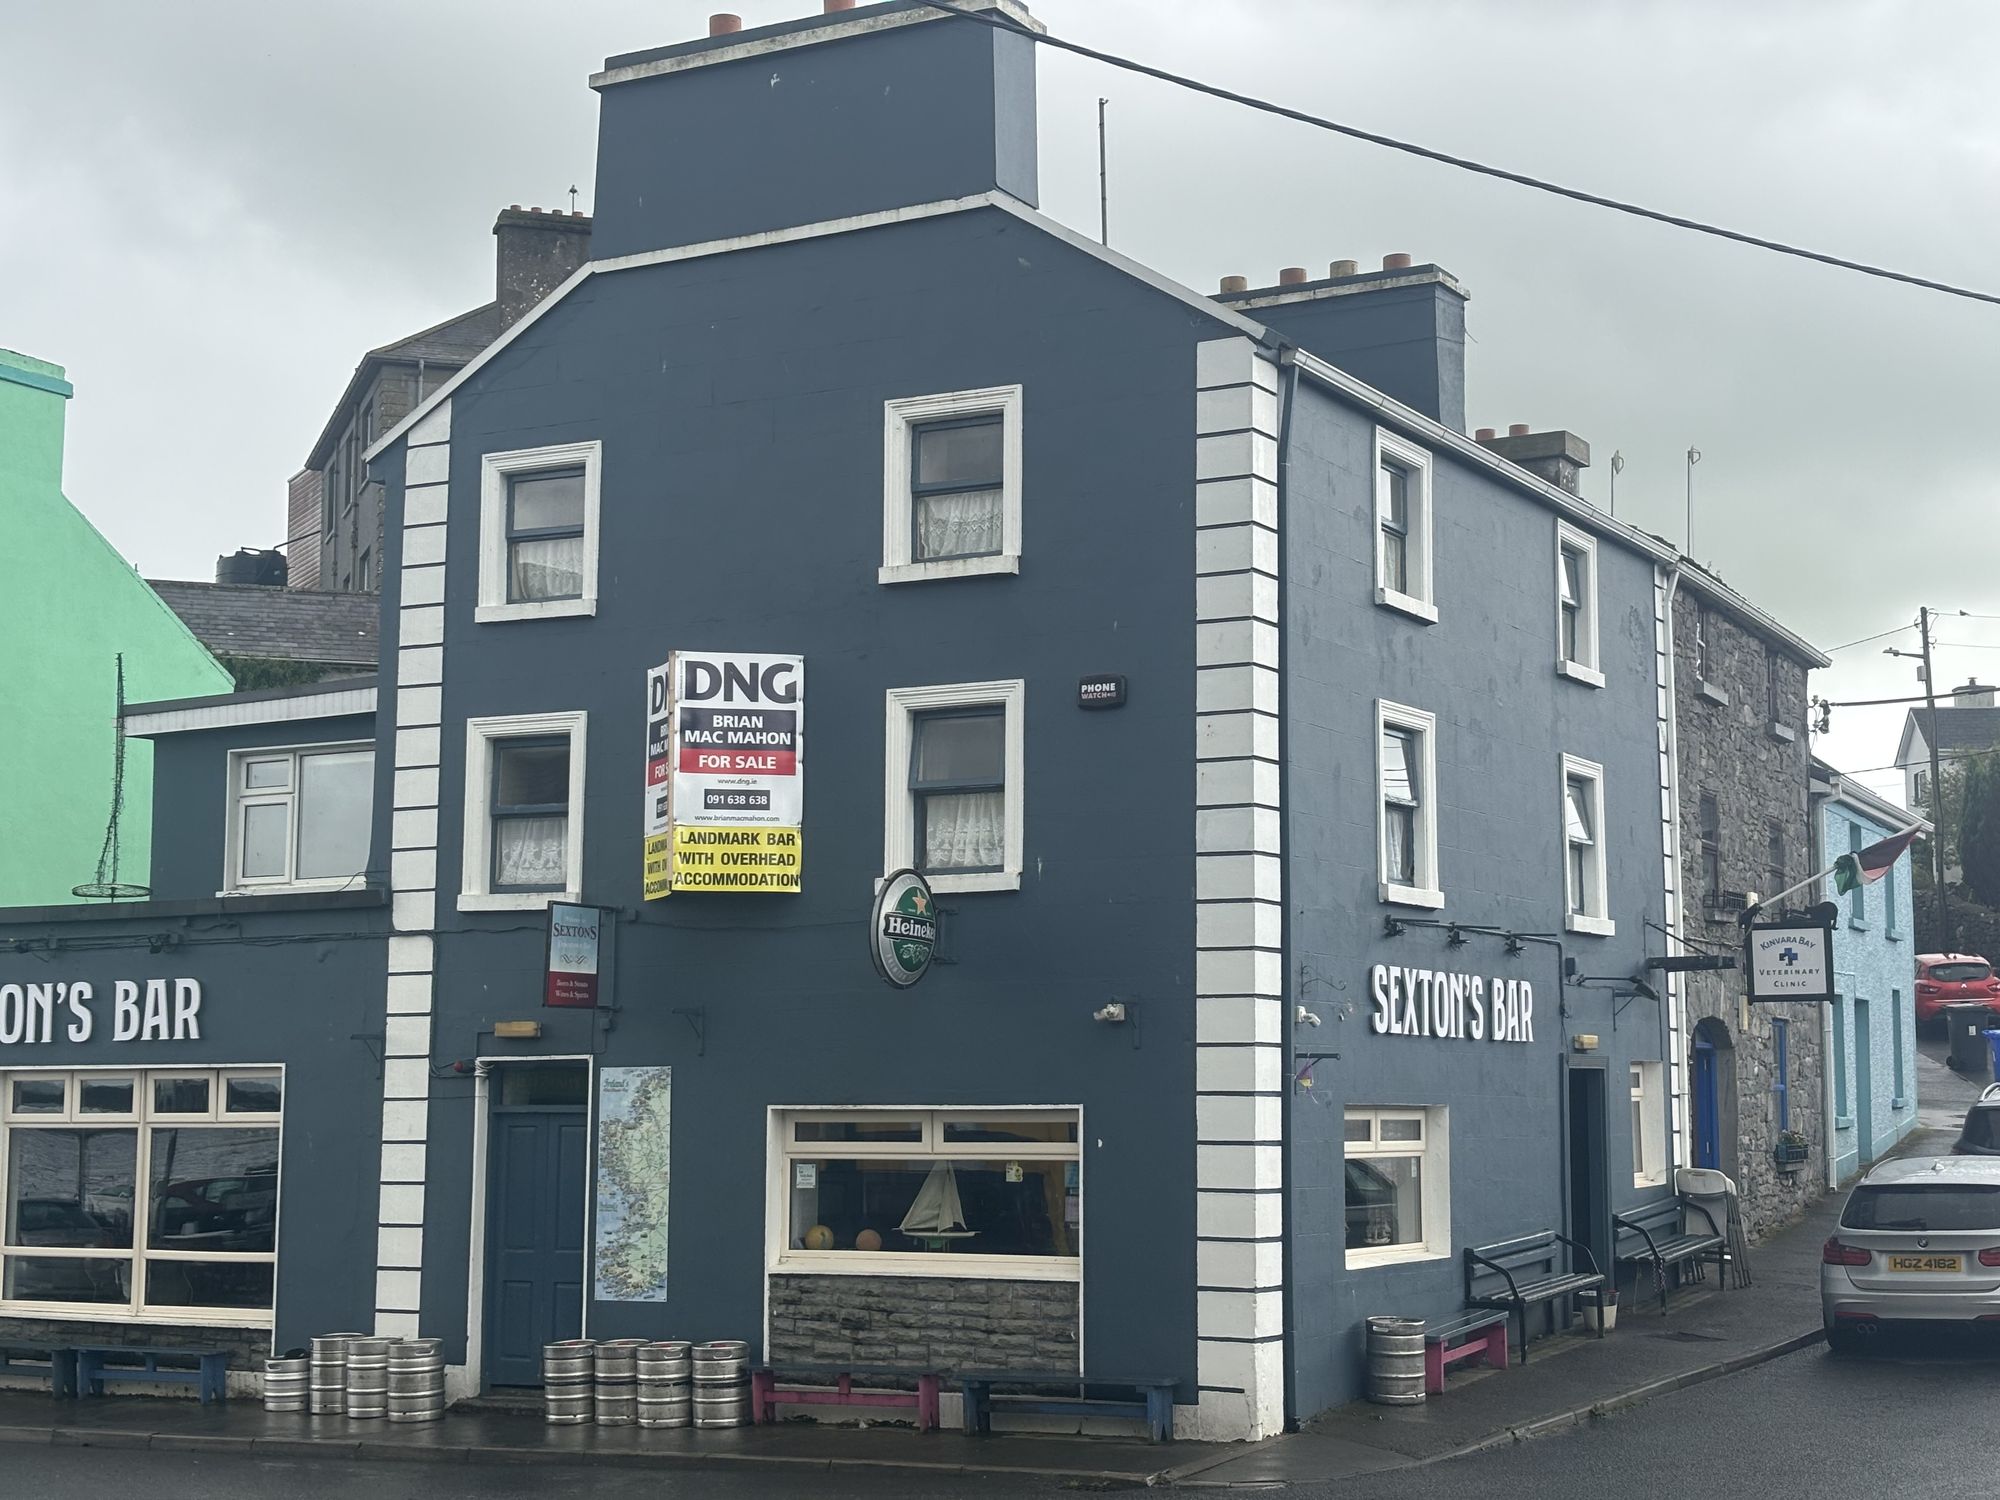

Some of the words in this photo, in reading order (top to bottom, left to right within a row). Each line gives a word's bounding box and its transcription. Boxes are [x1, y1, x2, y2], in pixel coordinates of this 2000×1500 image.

[685, 660, 797, 704] DNG
[1081, 683, 1116, 692] PHONE
[712, 715, 763, 728] BRIAN
[685, 730, 724, 743] MAC
[727, 731, 791, 745] MAHON
[699, 755, 731, 768] FOR
[735, 755, 777, 769] SALE
[717, 778, 757, 786] www.dng.ie
[707, 794, 724, 804] 091
[727, 795, 746, 804] 638
[749, 795, 767, 805] 638
[680, 832, 761, 846] LANDMARK
[767, 833, 795, 846] BAR
[678, 851, 714, 865] WITH
[721, 852, 795, 866] OVERHEAD
[675, 872, 799, 887] ACCOMMODATION
[553, 922, 597, 940] SEXTONS
[1760, 936, 1797, 950] KINVARA
[1798, 936, 1816, 948] BAY
[1759, 968, 1820, 976] VETERINARY
[1774, 980, 1807, 988] CLINIC
[1372, 964, 1484, 1041] SEXTON'S
[1492, 977, 1534, 1042] BAR
[0, 981, 93, 1044] ON'S
[112, 978, 201, 1042] BAR
[1893, 1258, 1922, 1269] HGZ
